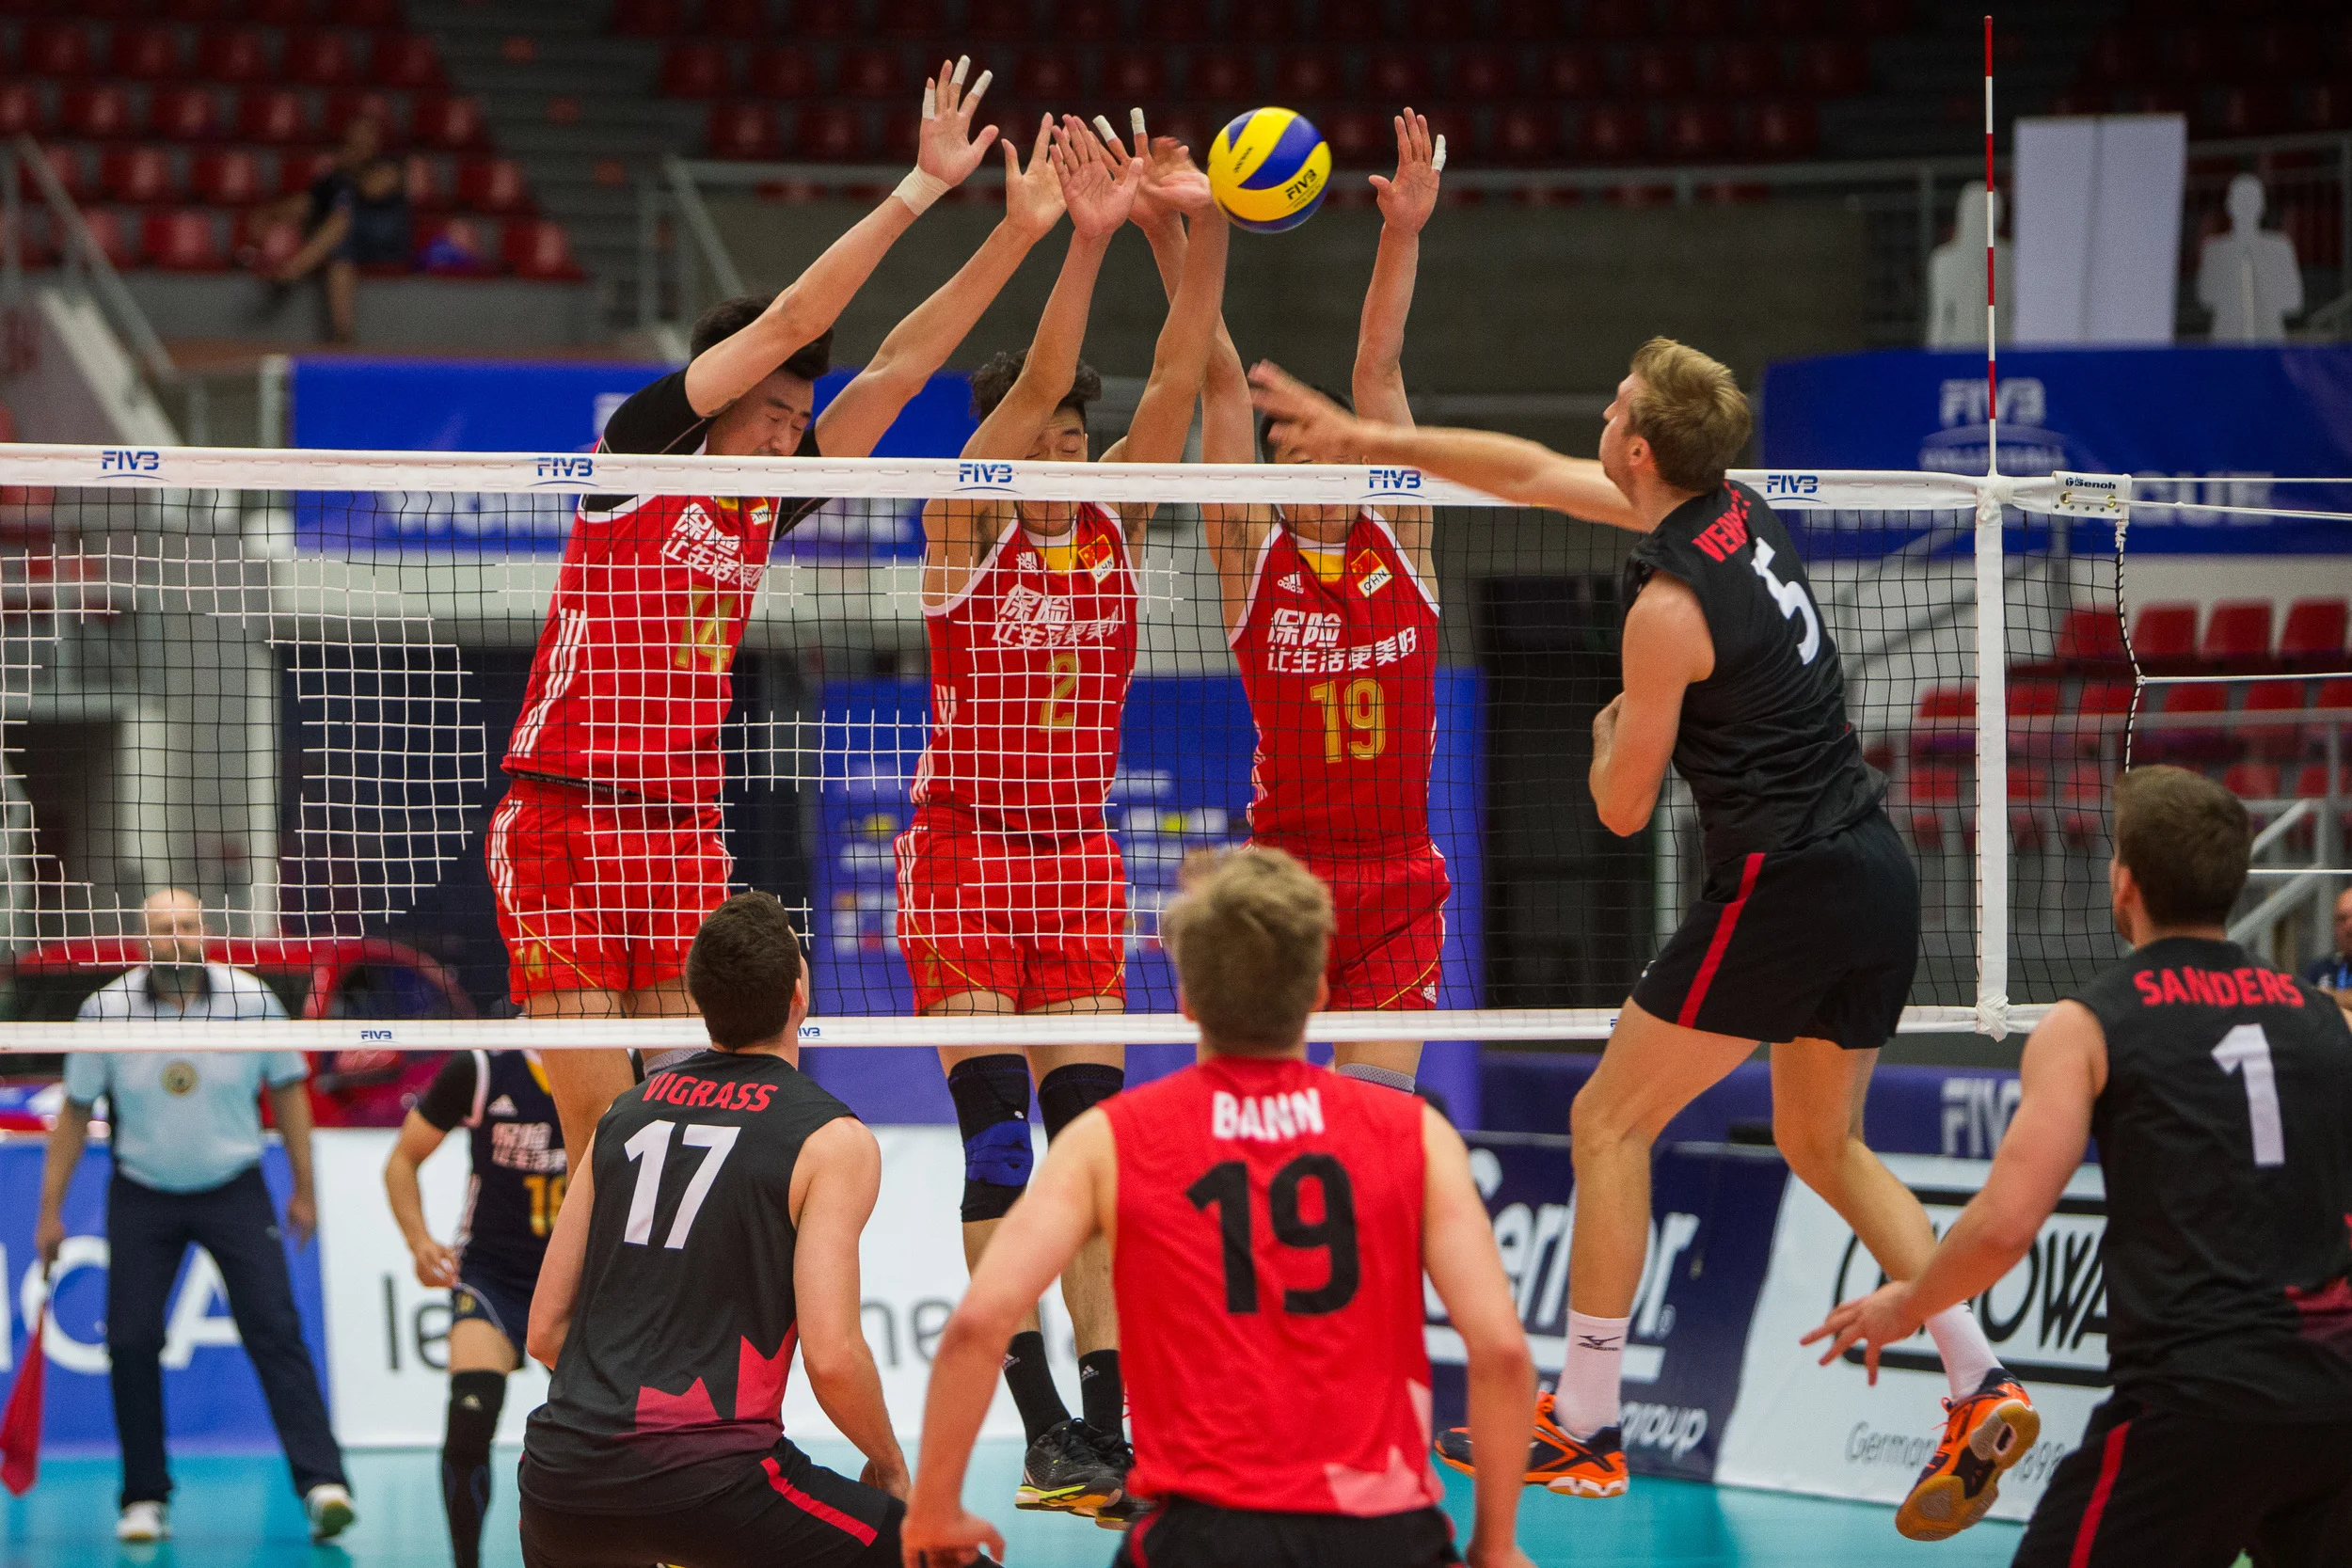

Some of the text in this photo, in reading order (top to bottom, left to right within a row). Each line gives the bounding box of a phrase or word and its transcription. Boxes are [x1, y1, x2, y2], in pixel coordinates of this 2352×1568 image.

[1285, 169, 1317, 200] FIVB
[102, 451, 159, 469] FIVB
[536, 458, 594, 477] FIVB
[958, 463, 1012, 483] FIVB
[1368, 468, 1422, 488] FIVB
[1767, 475, 1818, 493] FIVB
[2074, 477, 2116, 489] Senoh
[1364, 570, 1388, 592] CHN
[1751, 536, 1820, 665] 5
[998, 583, 1071, 631] 保险
[675, 584, 737, 674] 14
[1267, 608, 1342, 648] 保险
[1267, 626, 1417, 673] 让生活更美好
[1039, 652, 1082, 734] 2
[1310, 678, 1386, 764] 19
[2133, 965, 2305, 1008] SANDERS
[361, 1030, 392, 1040] FIVB
[798, 1027, 820, 1037] IVB
[643, 1072, 779, 1112] VIGRASS
[2211, 1022, 2286, 1168] 1
[1213, 1086, 1325, 1143] BANN
[624, 1119, 741, 1250] 17
[1185, 1151, 1362, 1315] 19
